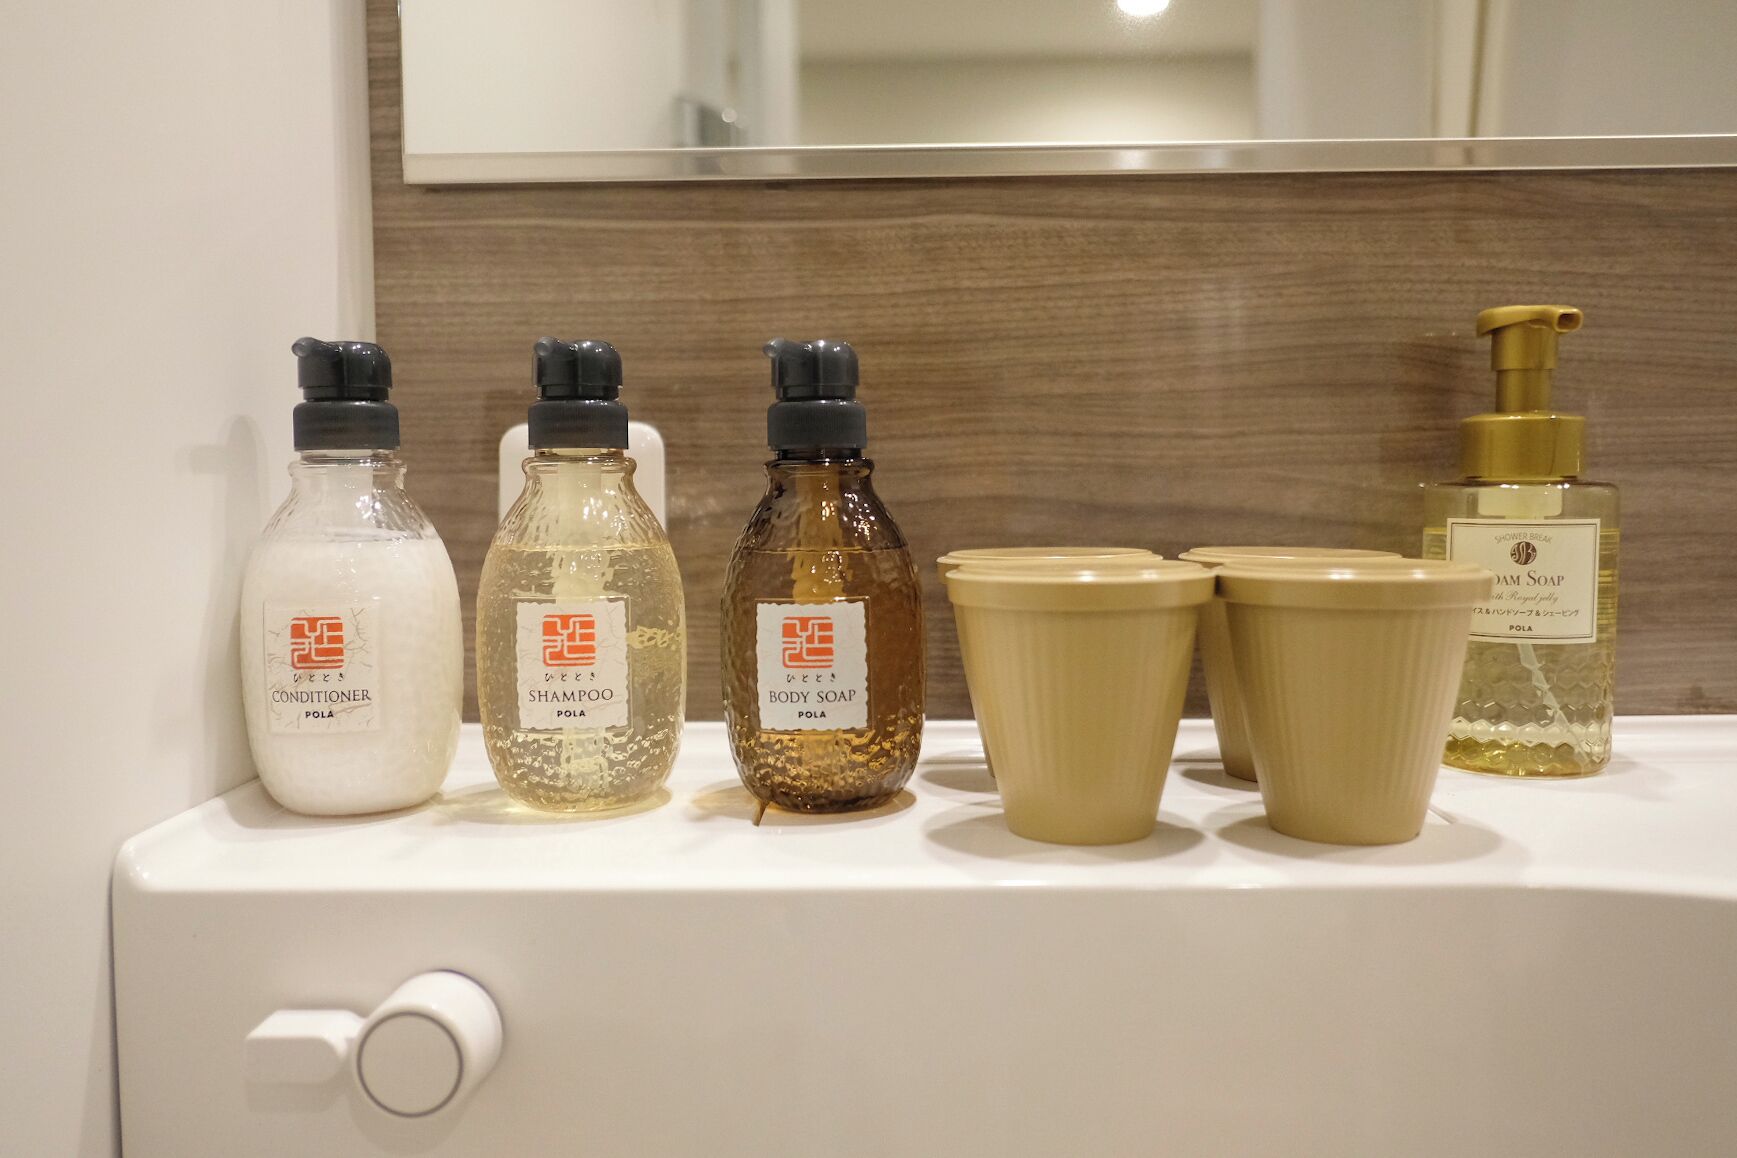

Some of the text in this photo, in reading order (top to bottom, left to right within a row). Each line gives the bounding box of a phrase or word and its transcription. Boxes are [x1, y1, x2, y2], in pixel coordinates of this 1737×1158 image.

[1494, 532, 1553, 544] SHOWER BREAK
[1495, 574, 1521, 586] AM
[1491, 592, 1504, 601] ith
[1506, 590, 1538, 605] Royal
[1509, 624, 1533, 632] POLA
[293, 672, 345, 683] ひととき
[545, 672, 596, 682] ひととき
[786, 672, 836, 683] ひととき
[271, 689, 372, 703] CONDITIONER
[528, 688, 614, 702] SHAMPOO
[769, 689, 857, 703] BODY SOAP
[305, 710, 335, 719] POLA
[557, 709, 587, 718] POLA
[798, 711, 827, 719] POLA
